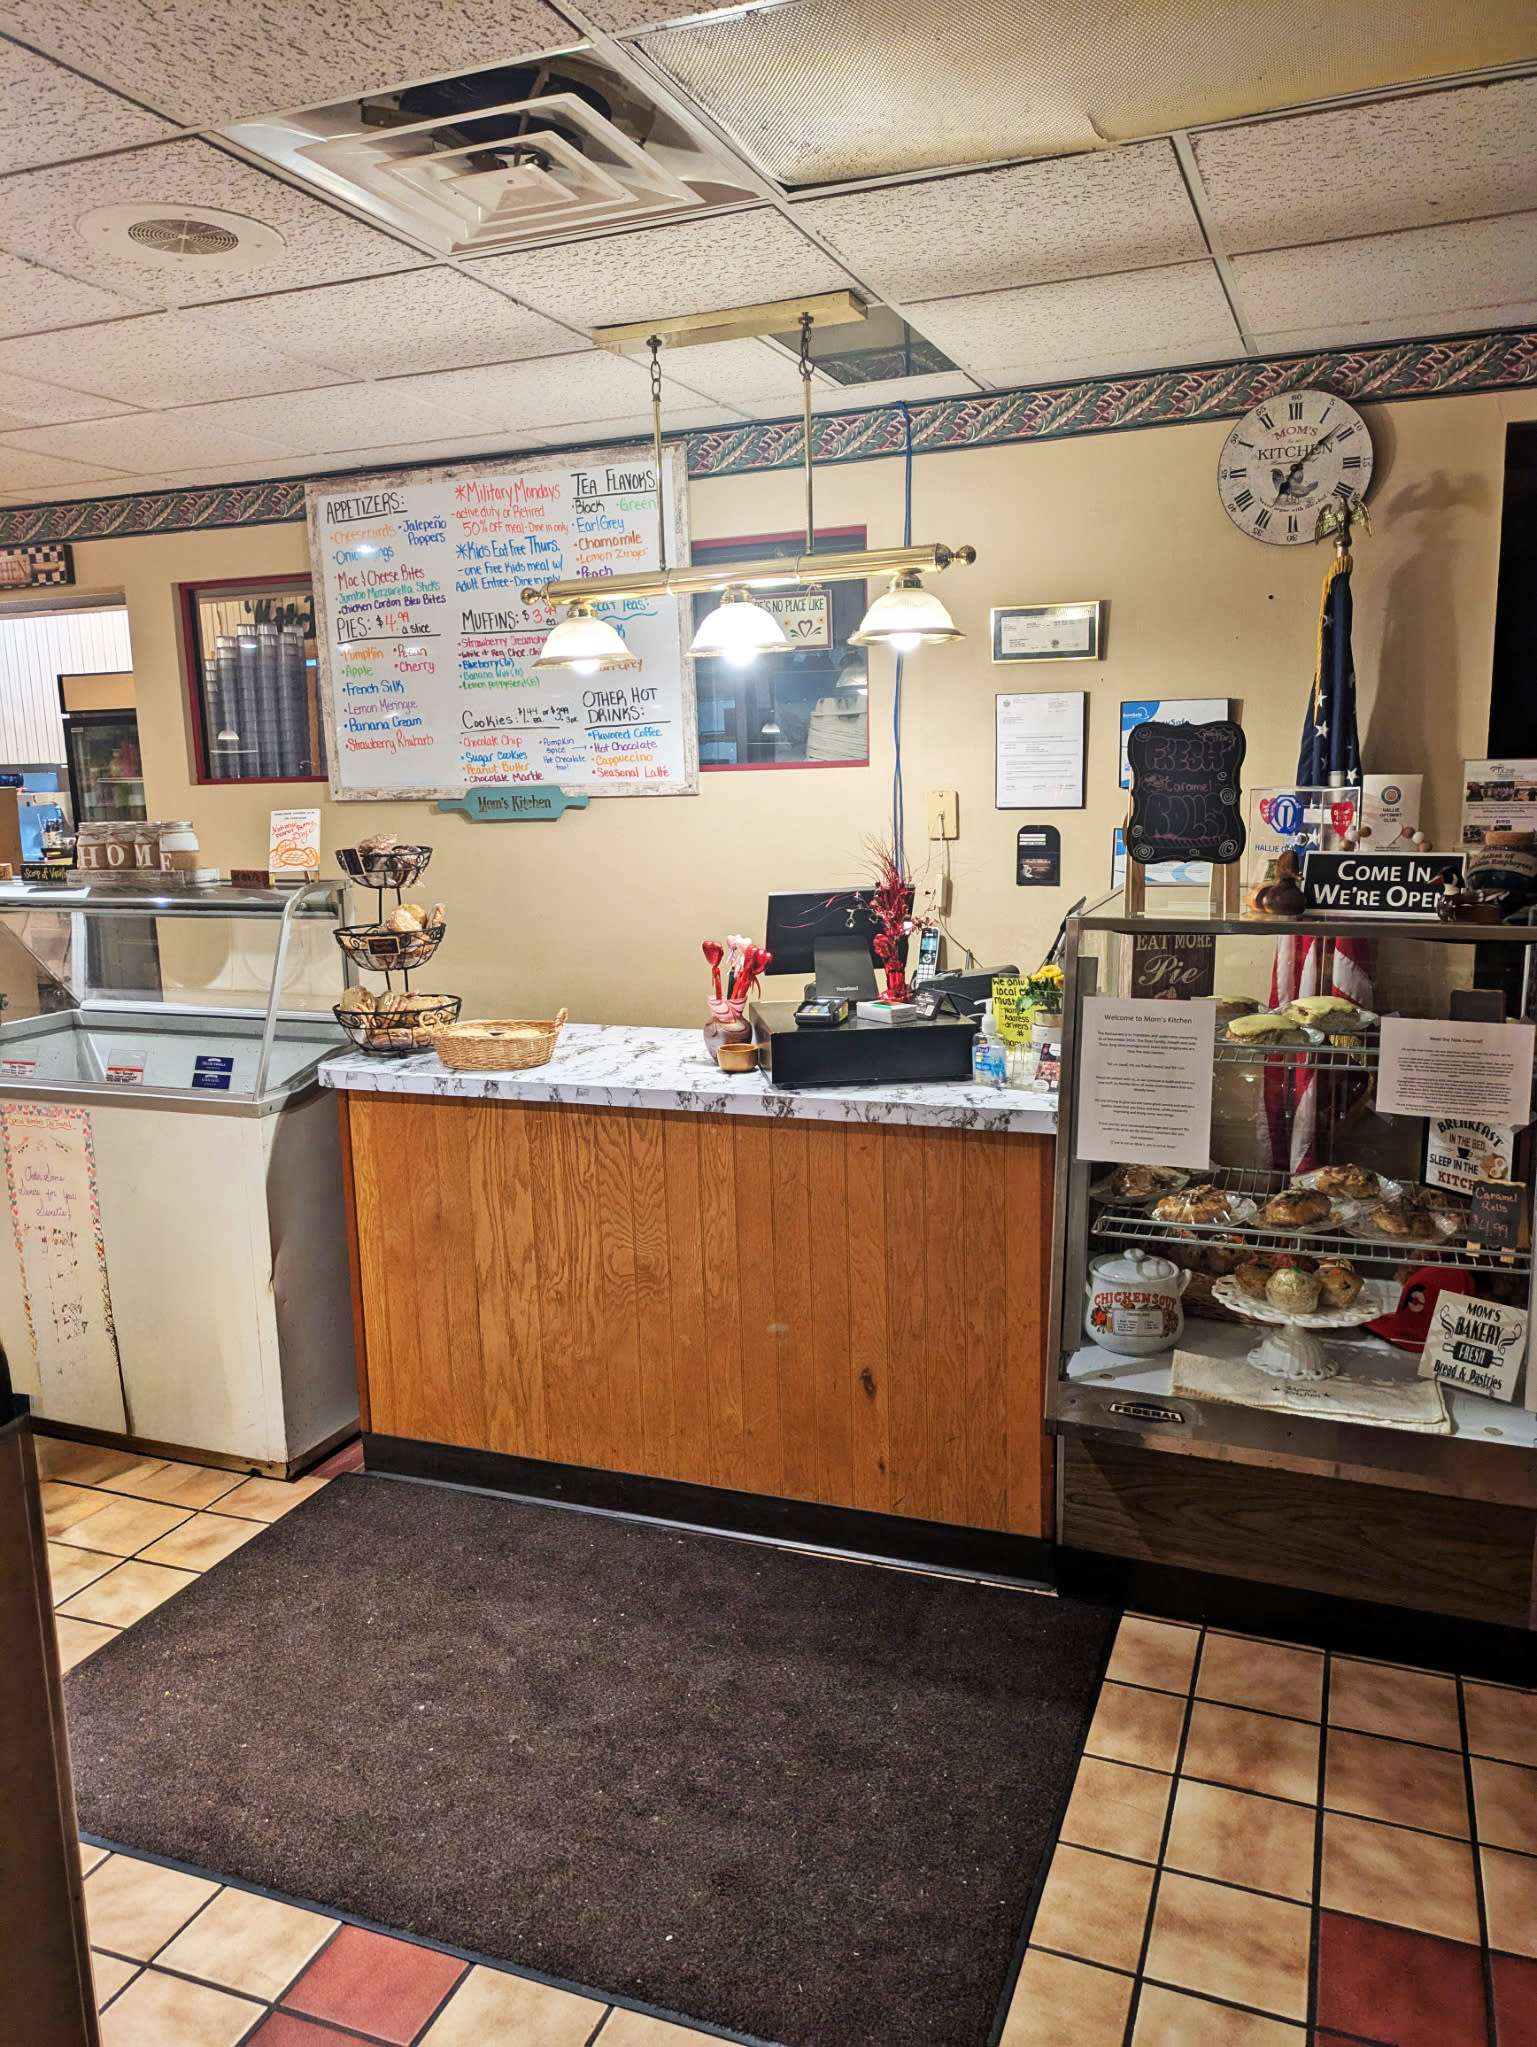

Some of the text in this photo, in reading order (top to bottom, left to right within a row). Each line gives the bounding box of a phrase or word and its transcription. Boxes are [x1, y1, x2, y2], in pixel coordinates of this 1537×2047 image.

[1274, 425, 1319, 440] MOM'S
[1258, 442, 1334, 461] KITCHEN
[571, 468, 656, 496] TEA FLAVORS
[466, 481, 513, 508] Military
[327, 492, 406, 524] APPETIZERS:
[456, 504, 545, 519] active duty or Retired
[575, 497, 656, 514] Black Green
[462, 520, 489, 537] 50%
[576, 514, 625, 534] Earl Grey
[408, 532, 446, 546] Poppers
[468, 535, 561, 560] Kids Eat Free Thurs.
[578, 530, 643, 551] Chamomile
[465, 566, 482, 576] one
[505, 560, 525, 574] Kids
[527, 558, 549, 572] meal
[552, 554, 563, 571] w/
[580, 550, 613, 564] Lemon
[338, 563, 425, 591] Mac Cheese Bites
[581, 565, 613, 579] Peach
[456, 577, 479, 592] Adult
[338, 590, 367, 605] Jumbo
[368, 584, 414, 600] Mozzarella
[341, 593, 447, 616] Chicken Cordon Bleu Bites
[773, 599, 783, 613] NO
[786, 599, 806, 612] PLACE
[809, 598, 824, 611] LIKE
[337, 616, 372, 641] PIES:
[410, 623, 431, 634] slice
[462, 609, 520, 632] MUFFINS:
[461, 637, 508, 648] Strawberry
[343, 646, 384, 662] Pumpkin
[345, 660, 436, 679] Apple Cherry
[463, 671, 494, 681] Banana
[346, 680, 405, 697] French Silk
[583, 687, 657, 707] OTHER HOT
[347, 702, 377, 716] Lemon
[588, 705, 645, 724] DRINKS:
[349, 715, 422, 733] Banana Cream
[462, 710, 520, 730] Cookies:
[348, 729, 434, 755] Strawberry Rhubarb
[501, 734, 522, 748] Chip
[543, 738, 574, 747] Pumpkin
[592, 727, 662, 741] Flavored Coffee
[594, 740, 658, 752] Hot Chocolate
[466, 750, 528, 767] Sugar Cookies
[467, 761, 530, 776] Peanut Butter
[469, 770, 544, 783] Chocolate Marble
[597, 767, 639, 778] Seasonal
[1164, 779, 1212, 793] Caramel
[477, 794, 551, 812] Mom's Kitchen
[1255, 844, 1279, 852] HALLIE
[1338, 860, 1431, 883] COME IN
[1314, 884, 1379, 907] WE'RE
[1135, 935, 1212, 951] EAT MORE
[1138, 954, 1208, 986] Pie
[996, 987, 1017, 996] local
[994, 997, 1015, 1006] must
[1104, 1014, 1135, 1023] Welcome
[1144, 1015, 1167, 1023] Mom's
[1168, 1016, 1193, 1025] Kitchen
[1437, 1118, 1504, 1148] BREAKFAST
[1449, 1133, 1456, 1143] IN
[1457, 1135, 1471, 1148] THE
[1430, 1153, 1479, 1175] SLEEP IN THE
[1438, 1170, 1475, 1191] KITC
[1475, 1187, 1518, 1203] Caramel
[1094, 1291, 1177, 1309] CHICKEN SOUP
[1466, 1303, 1501, 1322] MOM'S
[1454, 1317, 1504, 1346] BAKERY
[1458, 1345, 1486, 1365] FRESH
[1433, 1359, 1502, 1390] Bread & Pastries
[1115, 1404, 1177, 1421] FEDERAL
